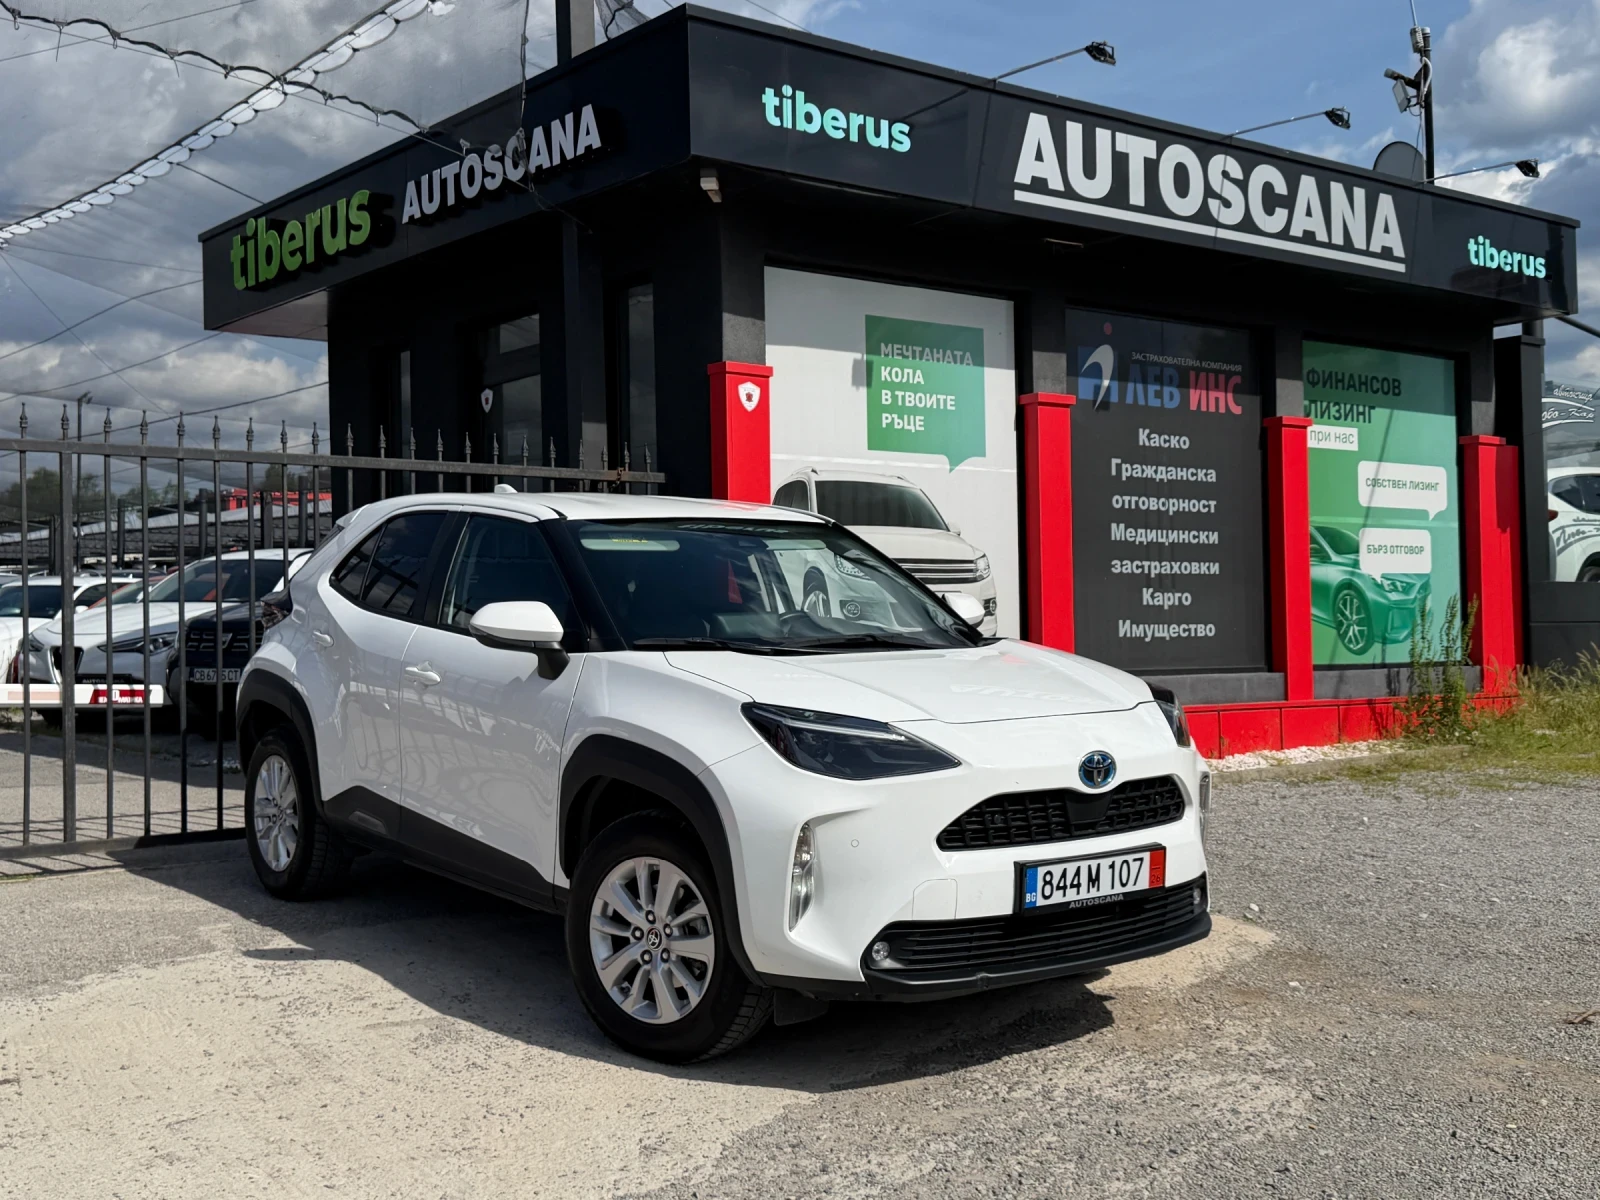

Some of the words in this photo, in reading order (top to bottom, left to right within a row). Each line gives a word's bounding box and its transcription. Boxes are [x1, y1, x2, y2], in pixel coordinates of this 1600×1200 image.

[761, 84, 911, 152] tiberus
[401, 104, 602, 224] AUTOSCANA
[1014, 112, 1405, 258] AUTOSCANA
[230, 189, 371, 290] tiberus
[1467, 235, 1546, 278] tiberus
[880, 342, 974, 367] МЕЧТАНАТА
[1131, 351, 1201, 368] ЗАСТРАХОВАТЕЛНА
[1202, 360, 1242, 372] КОМПАНИЯ
[881, 366, 925, 384] КОЛА
[1306, 368, 1402, 397] ФИНАНСОВ
[881, 389, 893, 405] В
[895, 391, 956, 411] ТВОИТЕ
[1125, 364, 1181, 409] ЛЕВ
[1189, 370, 1242, 415] ИНС
[1303, 399, 1376, 424] ЛИЗИНГ
[881, 413, 925, 433] РЪЦЕ
[1138, 428, 1190, 449] Каско
[1309, 429, 1331, 445] при
[1334, 431, 1355, 444] нас
[1111, 458, 1217, 482] Гражданска
[1365, 477, 1407, 490] СОБСТВЕН
[1408, 481, 1440, 492] ЛИЗИНГ
[1112, 494, 1217, 515] отговорност
[1111, 522, 1219, 546] Медицински
[1366, 544, 1388, 555] БЪРЗ
[1389, 545, 1425, 555] ОТГОВОР
[1111, 559, 1220, 577] застраховки
[1142, 588, 1192, 609] Карго
[1118, 620, 1216, 642] Имущество
[1025, 892, 1037, 903] BG
[1069, 893, 1124, 909] AUTOSCANA
